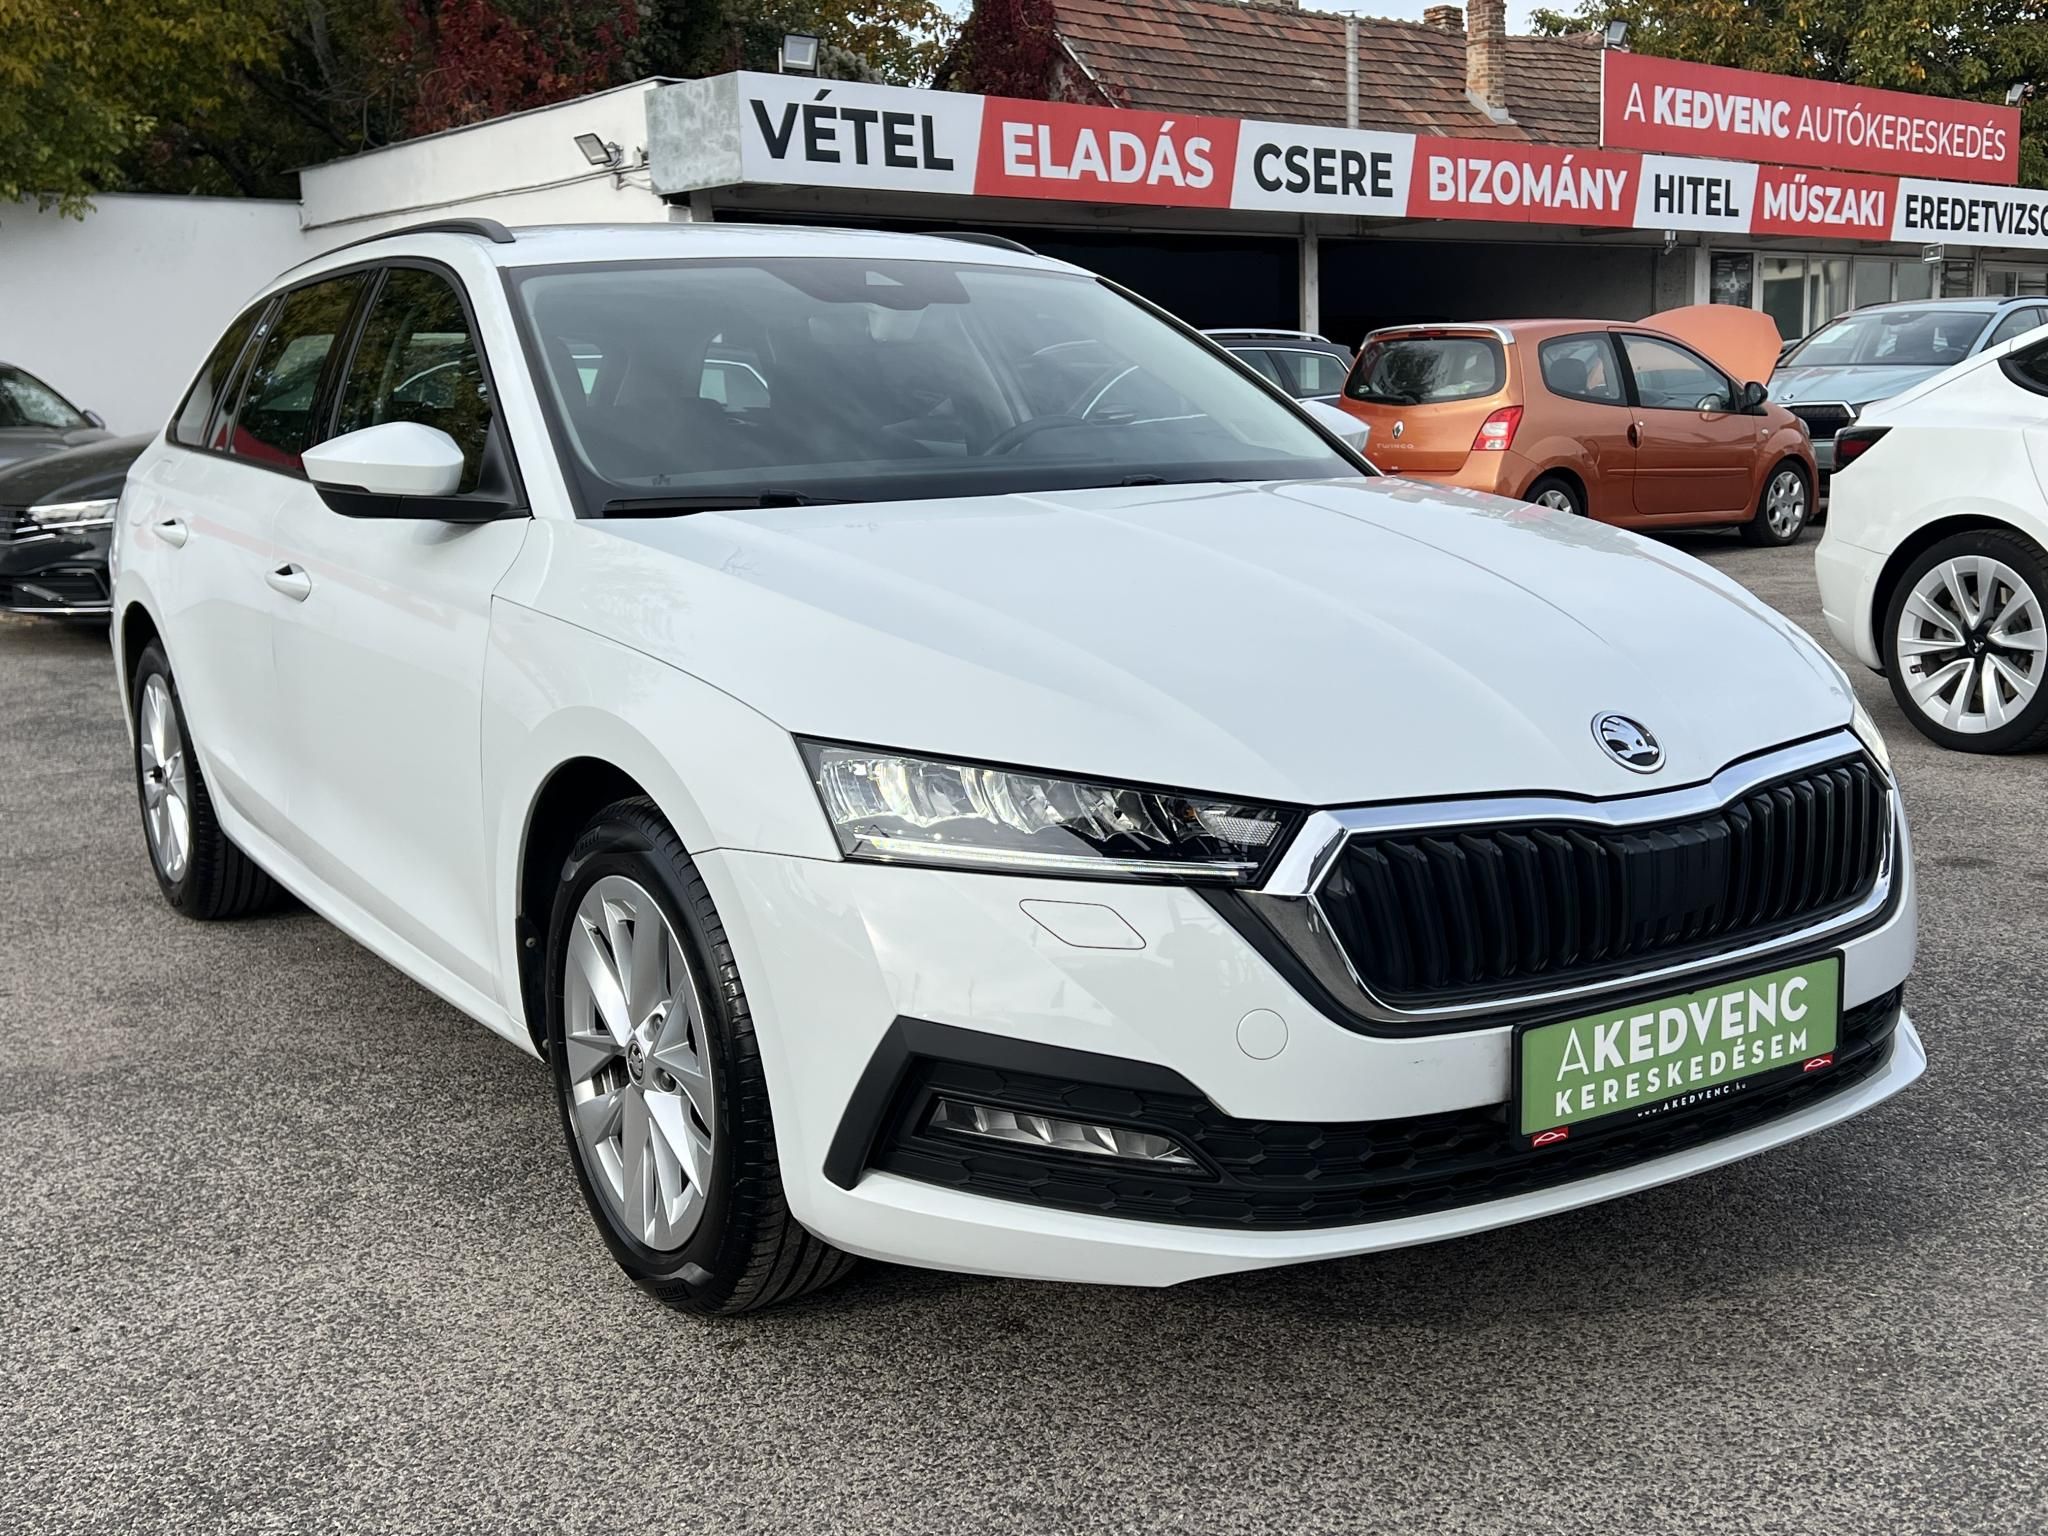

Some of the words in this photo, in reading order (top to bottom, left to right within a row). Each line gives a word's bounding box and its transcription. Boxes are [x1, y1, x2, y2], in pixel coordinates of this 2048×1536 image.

[750, 89, 954, 172] VÉTEL
[1623, 82, 1647, 123] A
[1653, 85, 1790, 139] KEDVENC
[1796, 102, 2006, 162] AUTÓKERESKEDÉS
[1002, 121, 1214, 189] ELADÁS
[1253, 143, 1393, 198] CSERE
[1428, 154, 1628, 212] BIZOMÁNY
[1654, 173, 1739, 218] HITEL
[1763, 174, 1885, 228] MŰSZAKI
[1555, 1028, 1808, 1117] KERESKEDÉSEM
